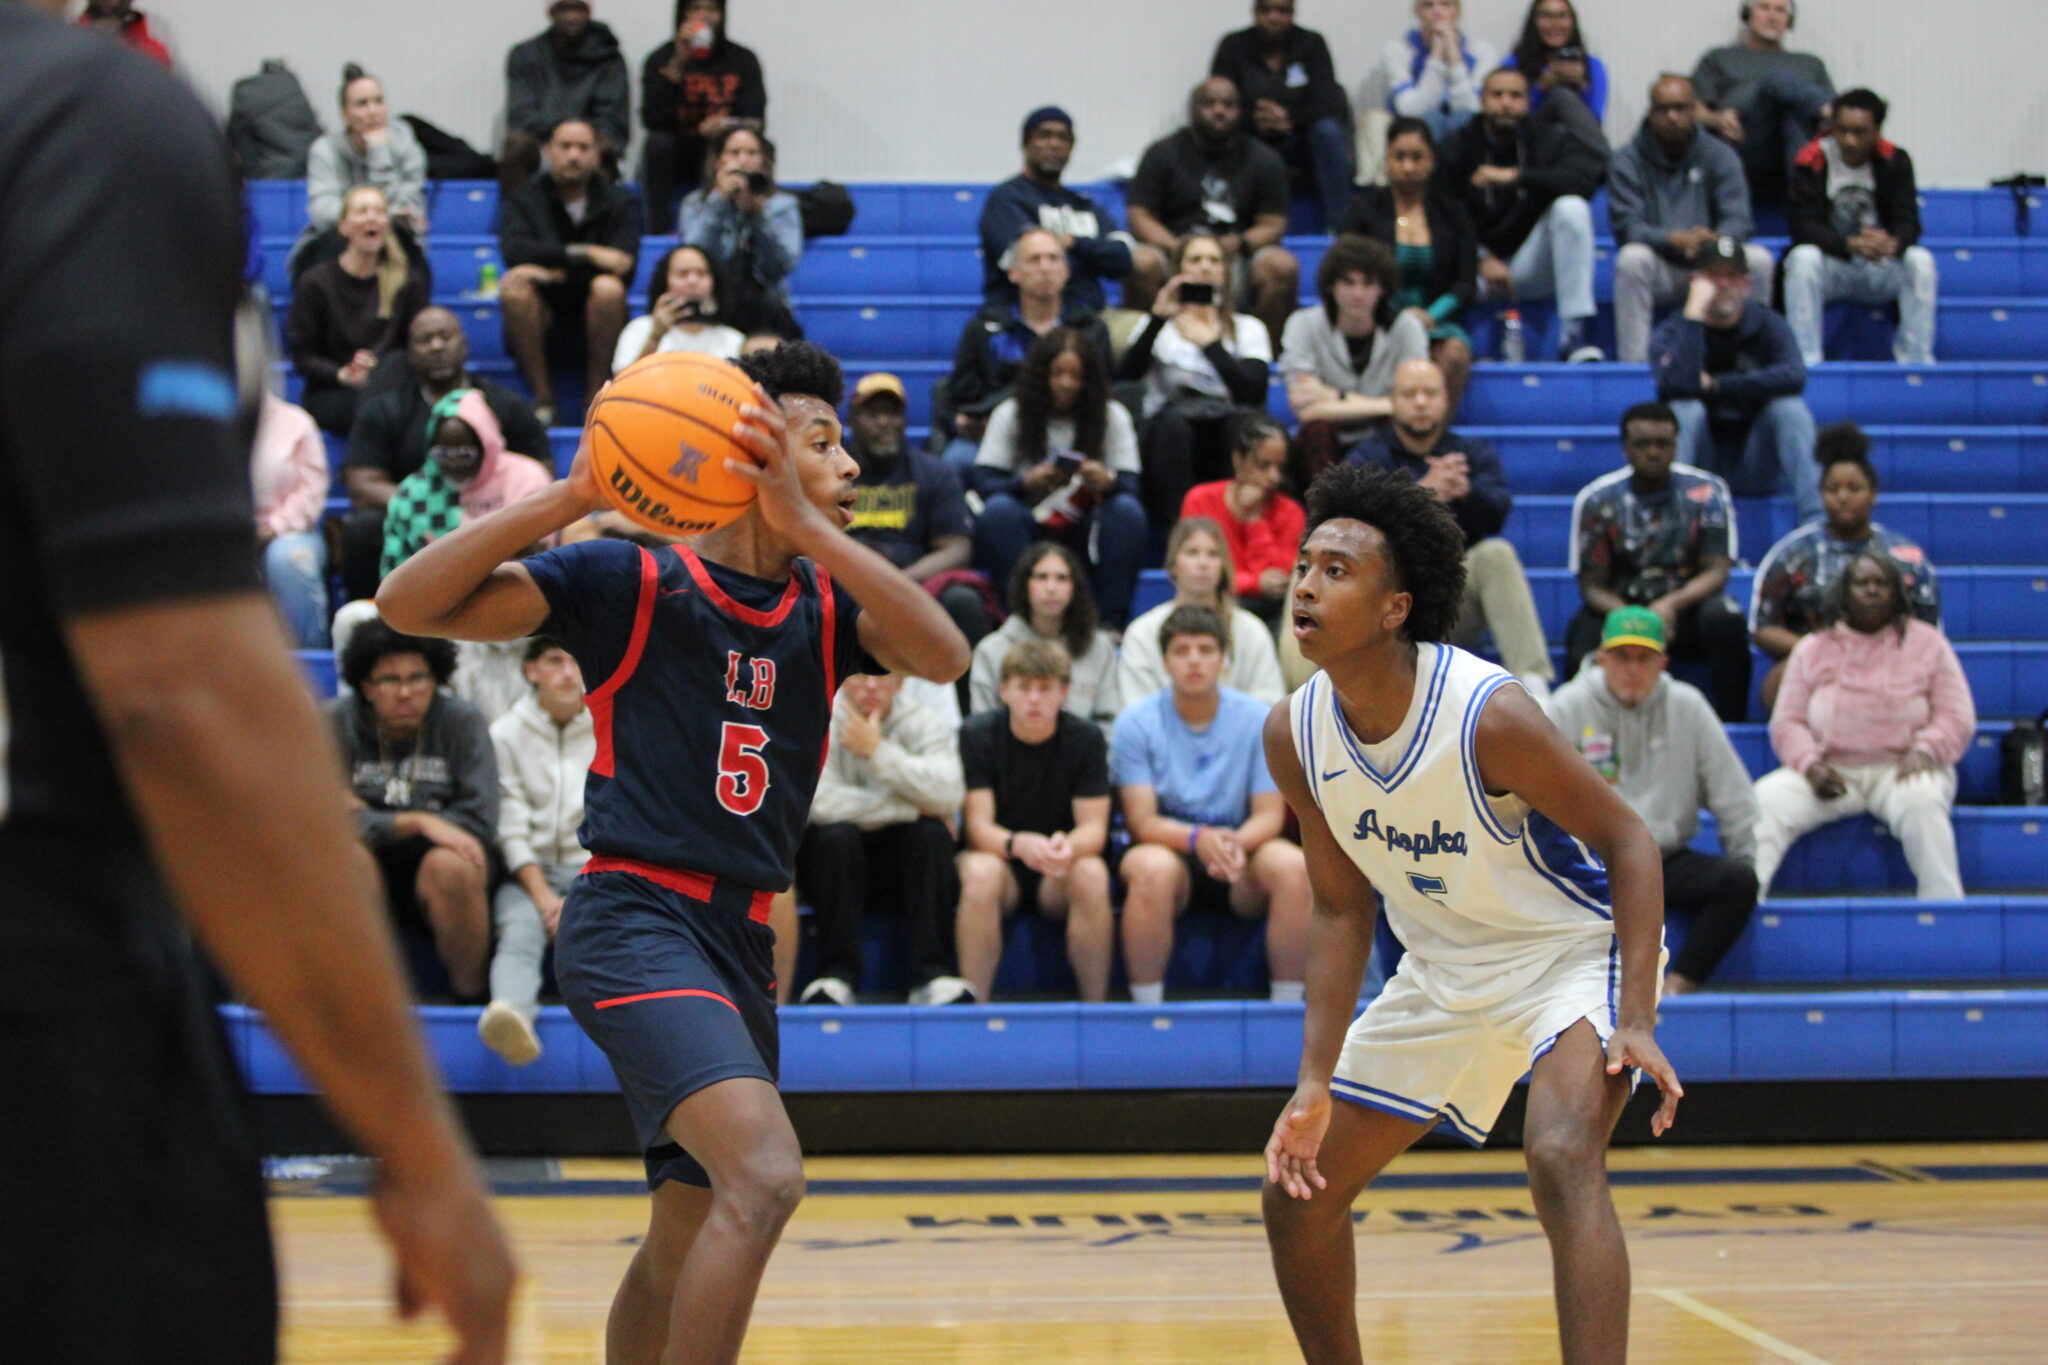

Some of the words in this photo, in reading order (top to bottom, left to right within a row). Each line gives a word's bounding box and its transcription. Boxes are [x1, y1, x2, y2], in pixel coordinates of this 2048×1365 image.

[609, 462, 718, 532] Wilson
[724, 650, 777, 710] LB
[715, 721, 772, 816] 5
[1353, 809, 1468, 862] Apopka
